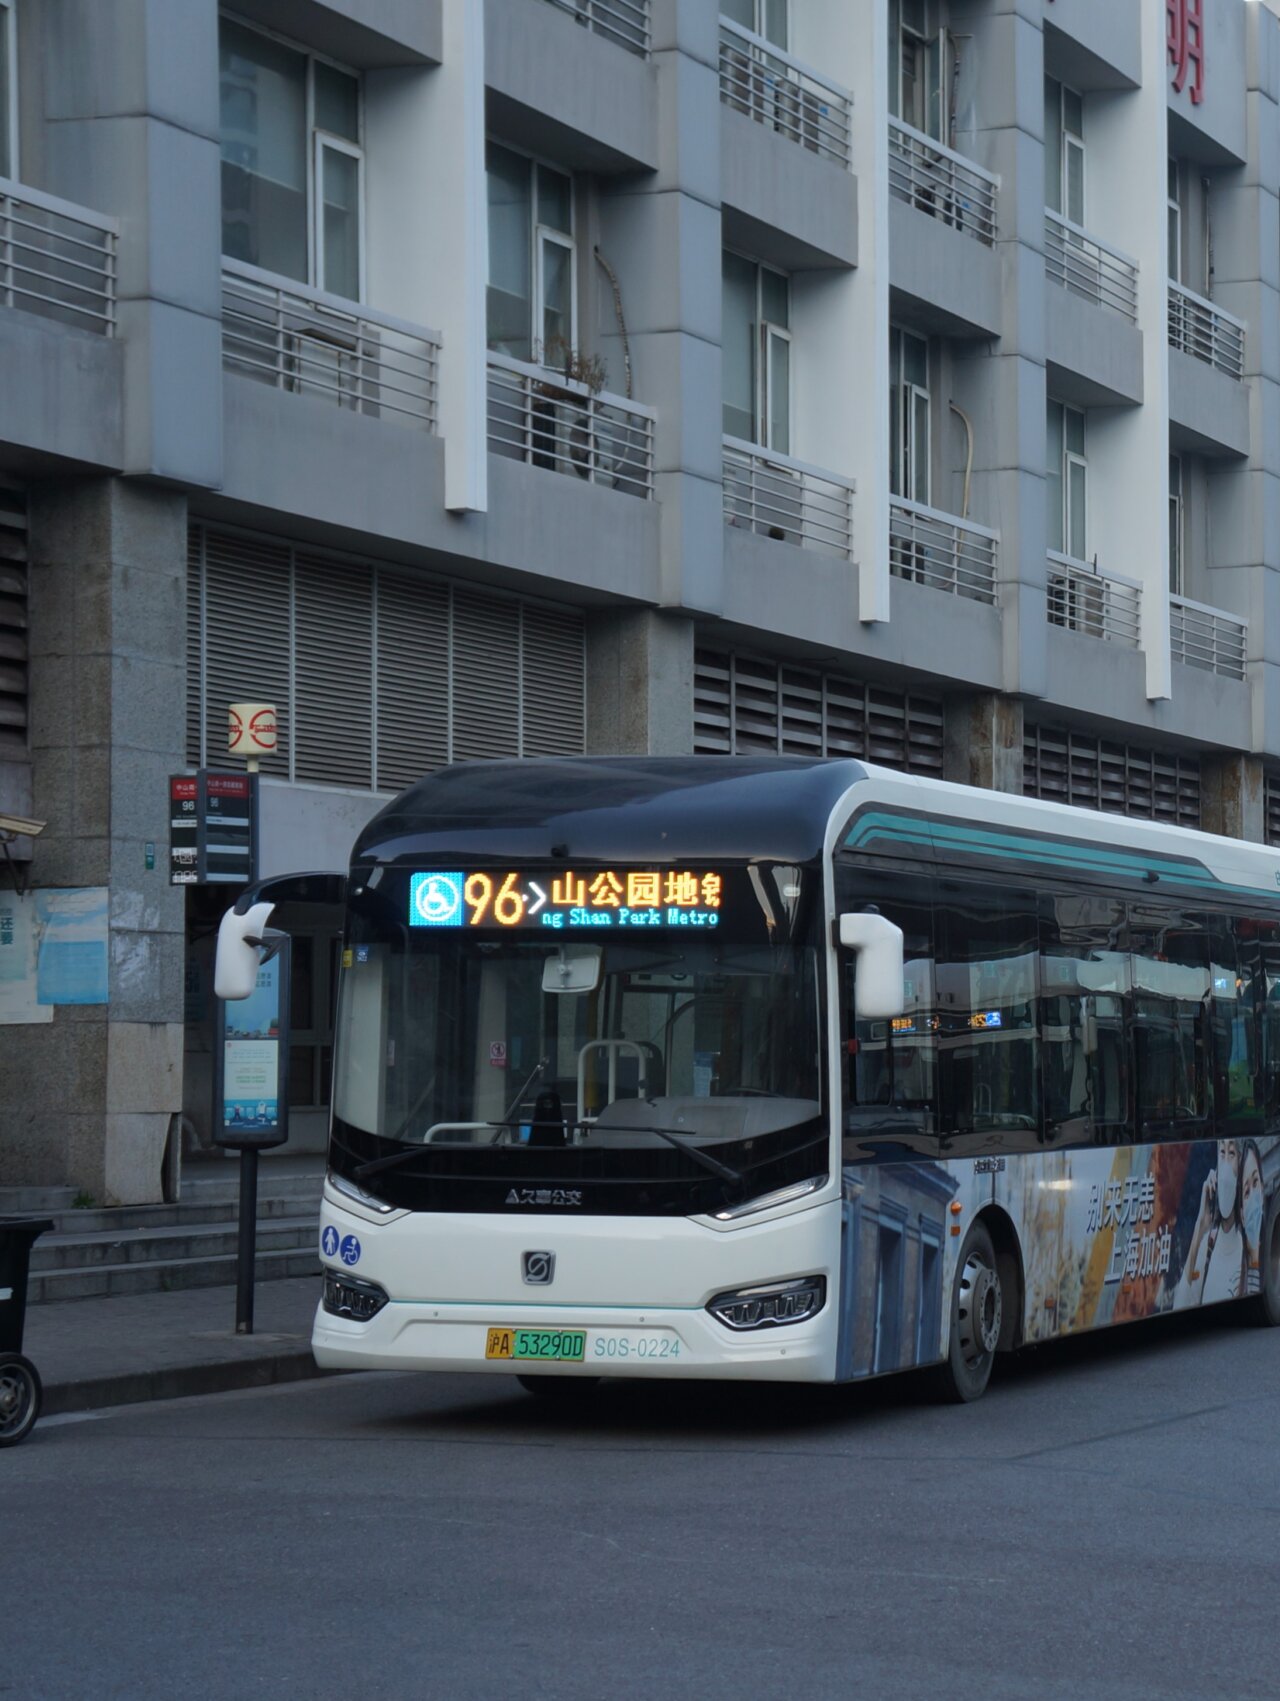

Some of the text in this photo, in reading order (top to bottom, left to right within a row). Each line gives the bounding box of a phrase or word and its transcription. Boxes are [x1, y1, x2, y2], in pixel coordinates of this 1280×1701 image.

[463, 872, 524, 925] 96
[570, 910, 610, 925] Shan
[618, 910, 659, 925] Park
[667, 910, 719, 925] Metro
[1086, 1172, 1156, 1234] 别来无恙
[1103, 1223, 1172, 1286] 上海加油
[489, 1332, 585, 1357] 沪A 53290D
